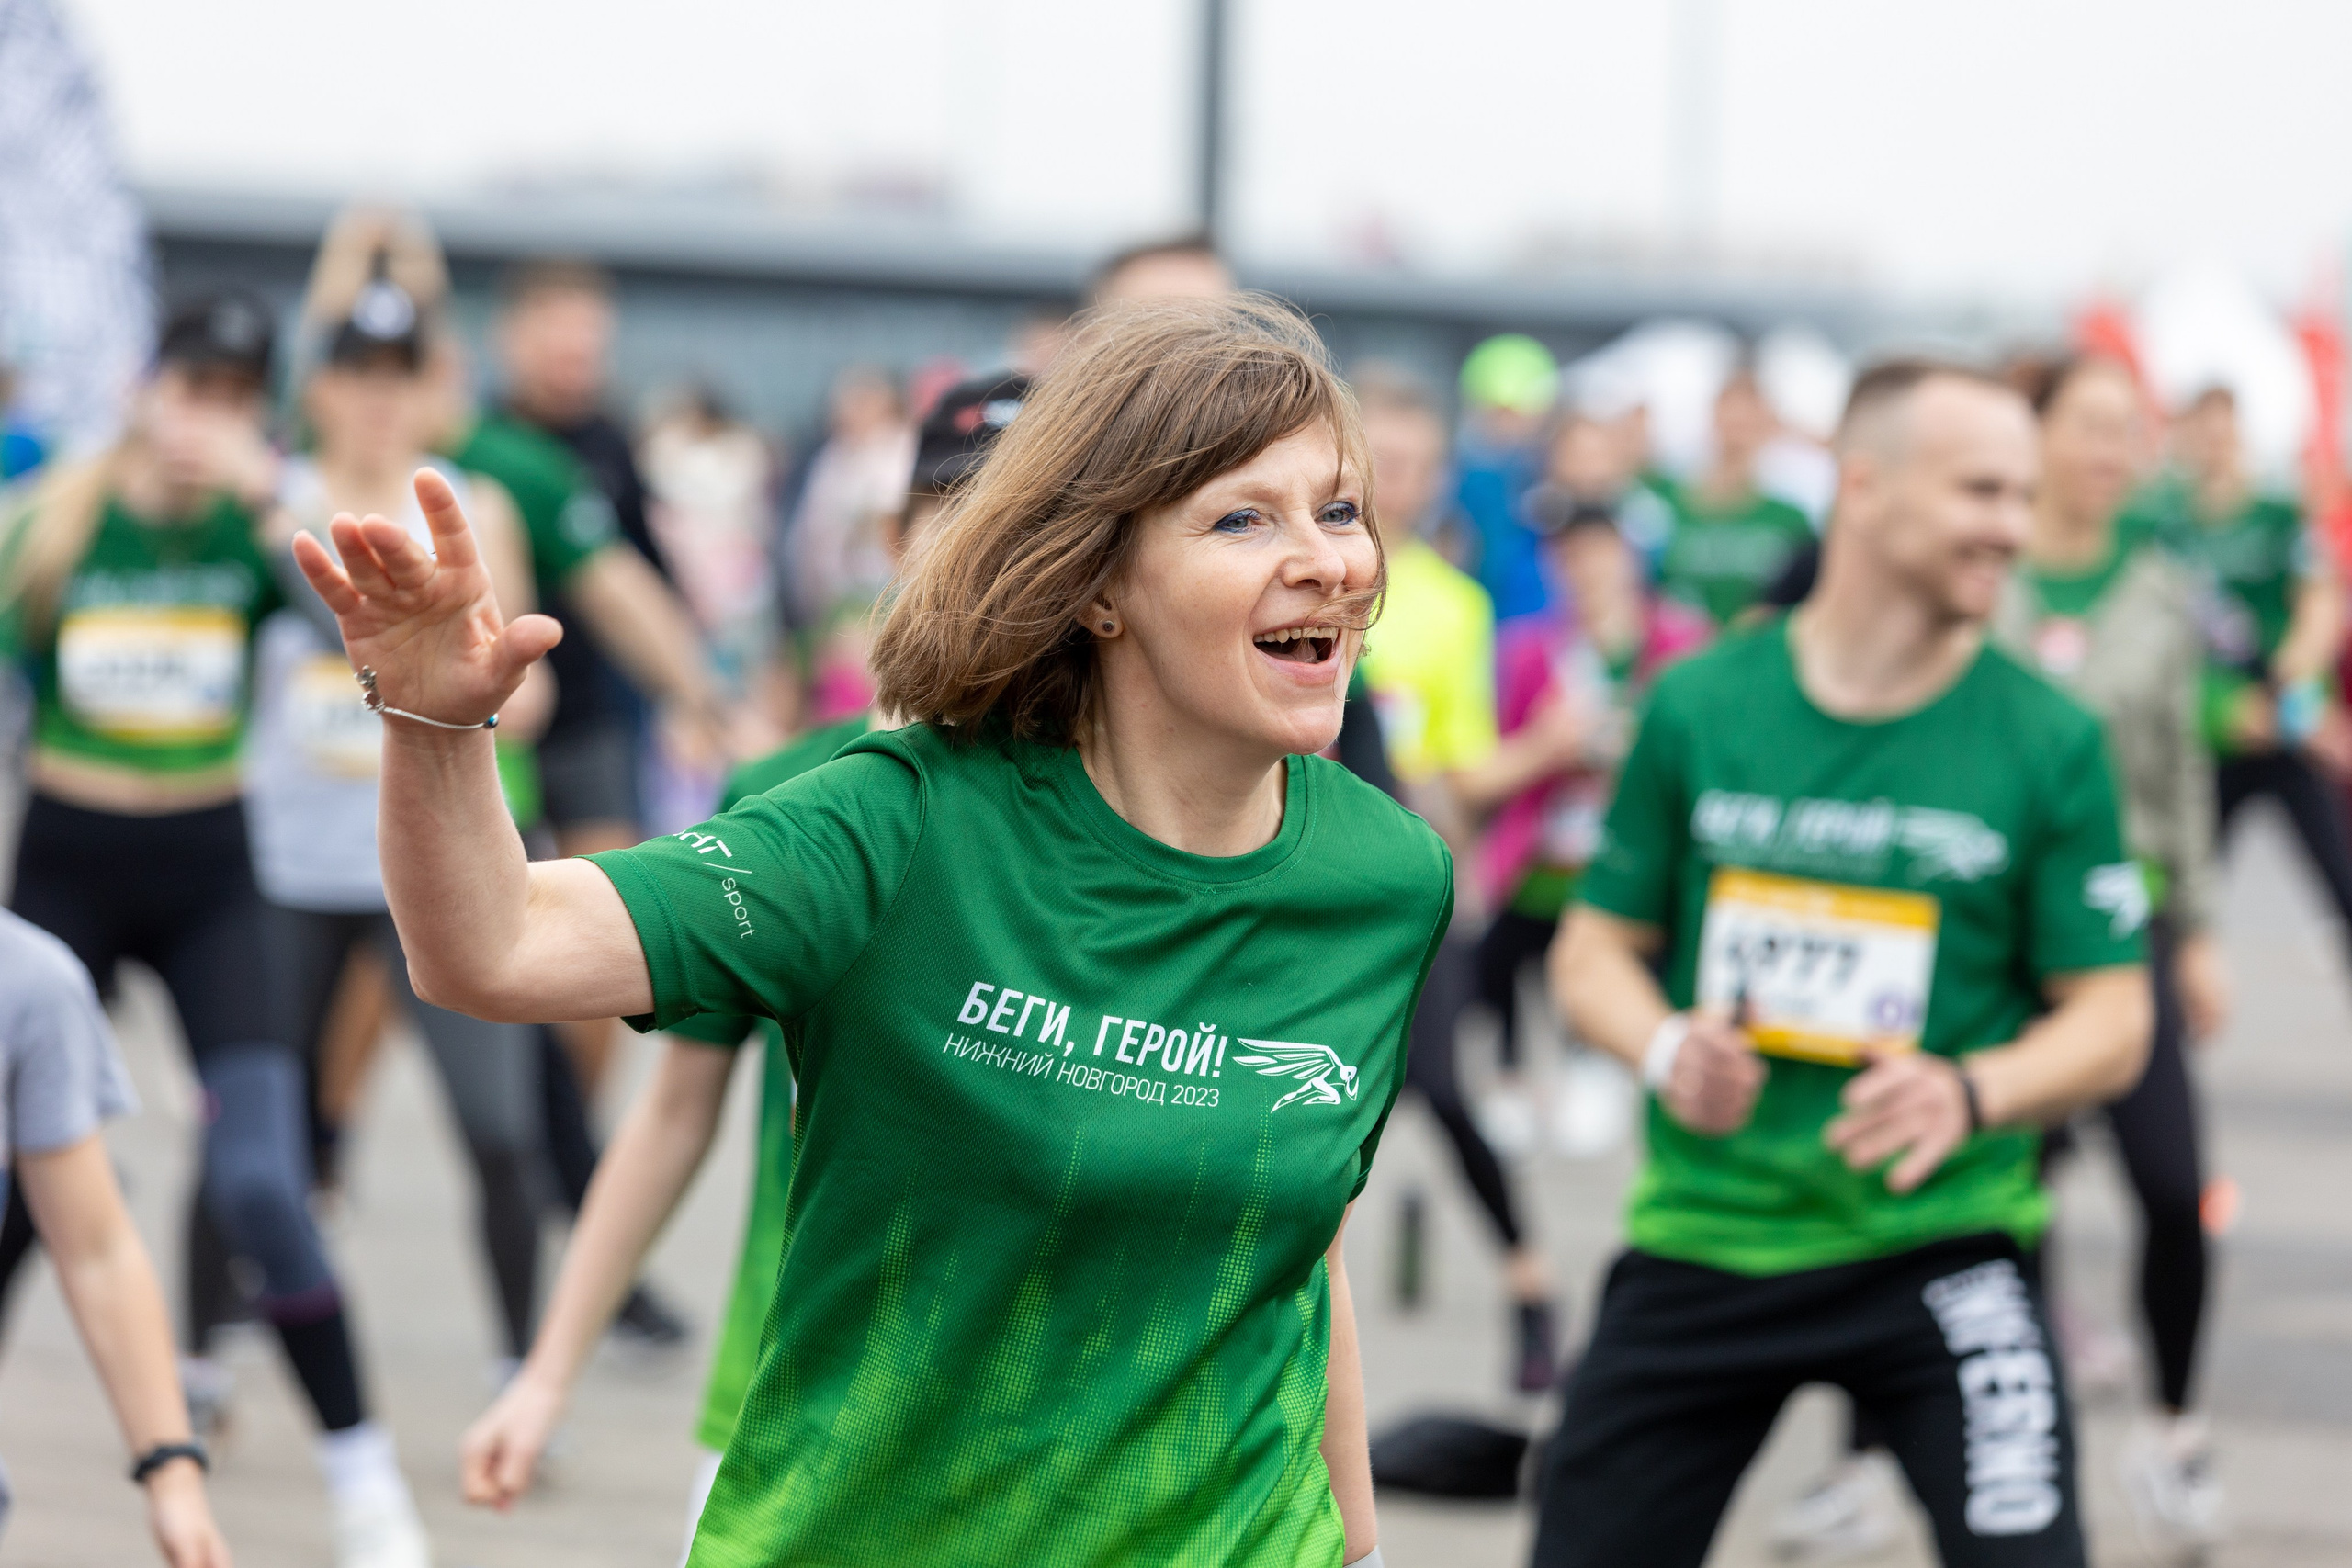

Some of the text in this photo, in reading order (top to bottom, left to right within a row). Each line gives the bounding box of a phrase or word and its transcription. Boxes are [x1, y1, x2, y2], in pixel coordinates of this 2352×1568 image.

[721, 877, 755, 939] sport
[956, 981, 1229, 1077] БЕГИ, ГЕРОЙ!
[943, 1032, 1220, 1108] НИЖНИЙ НОВГОРОД 2023
